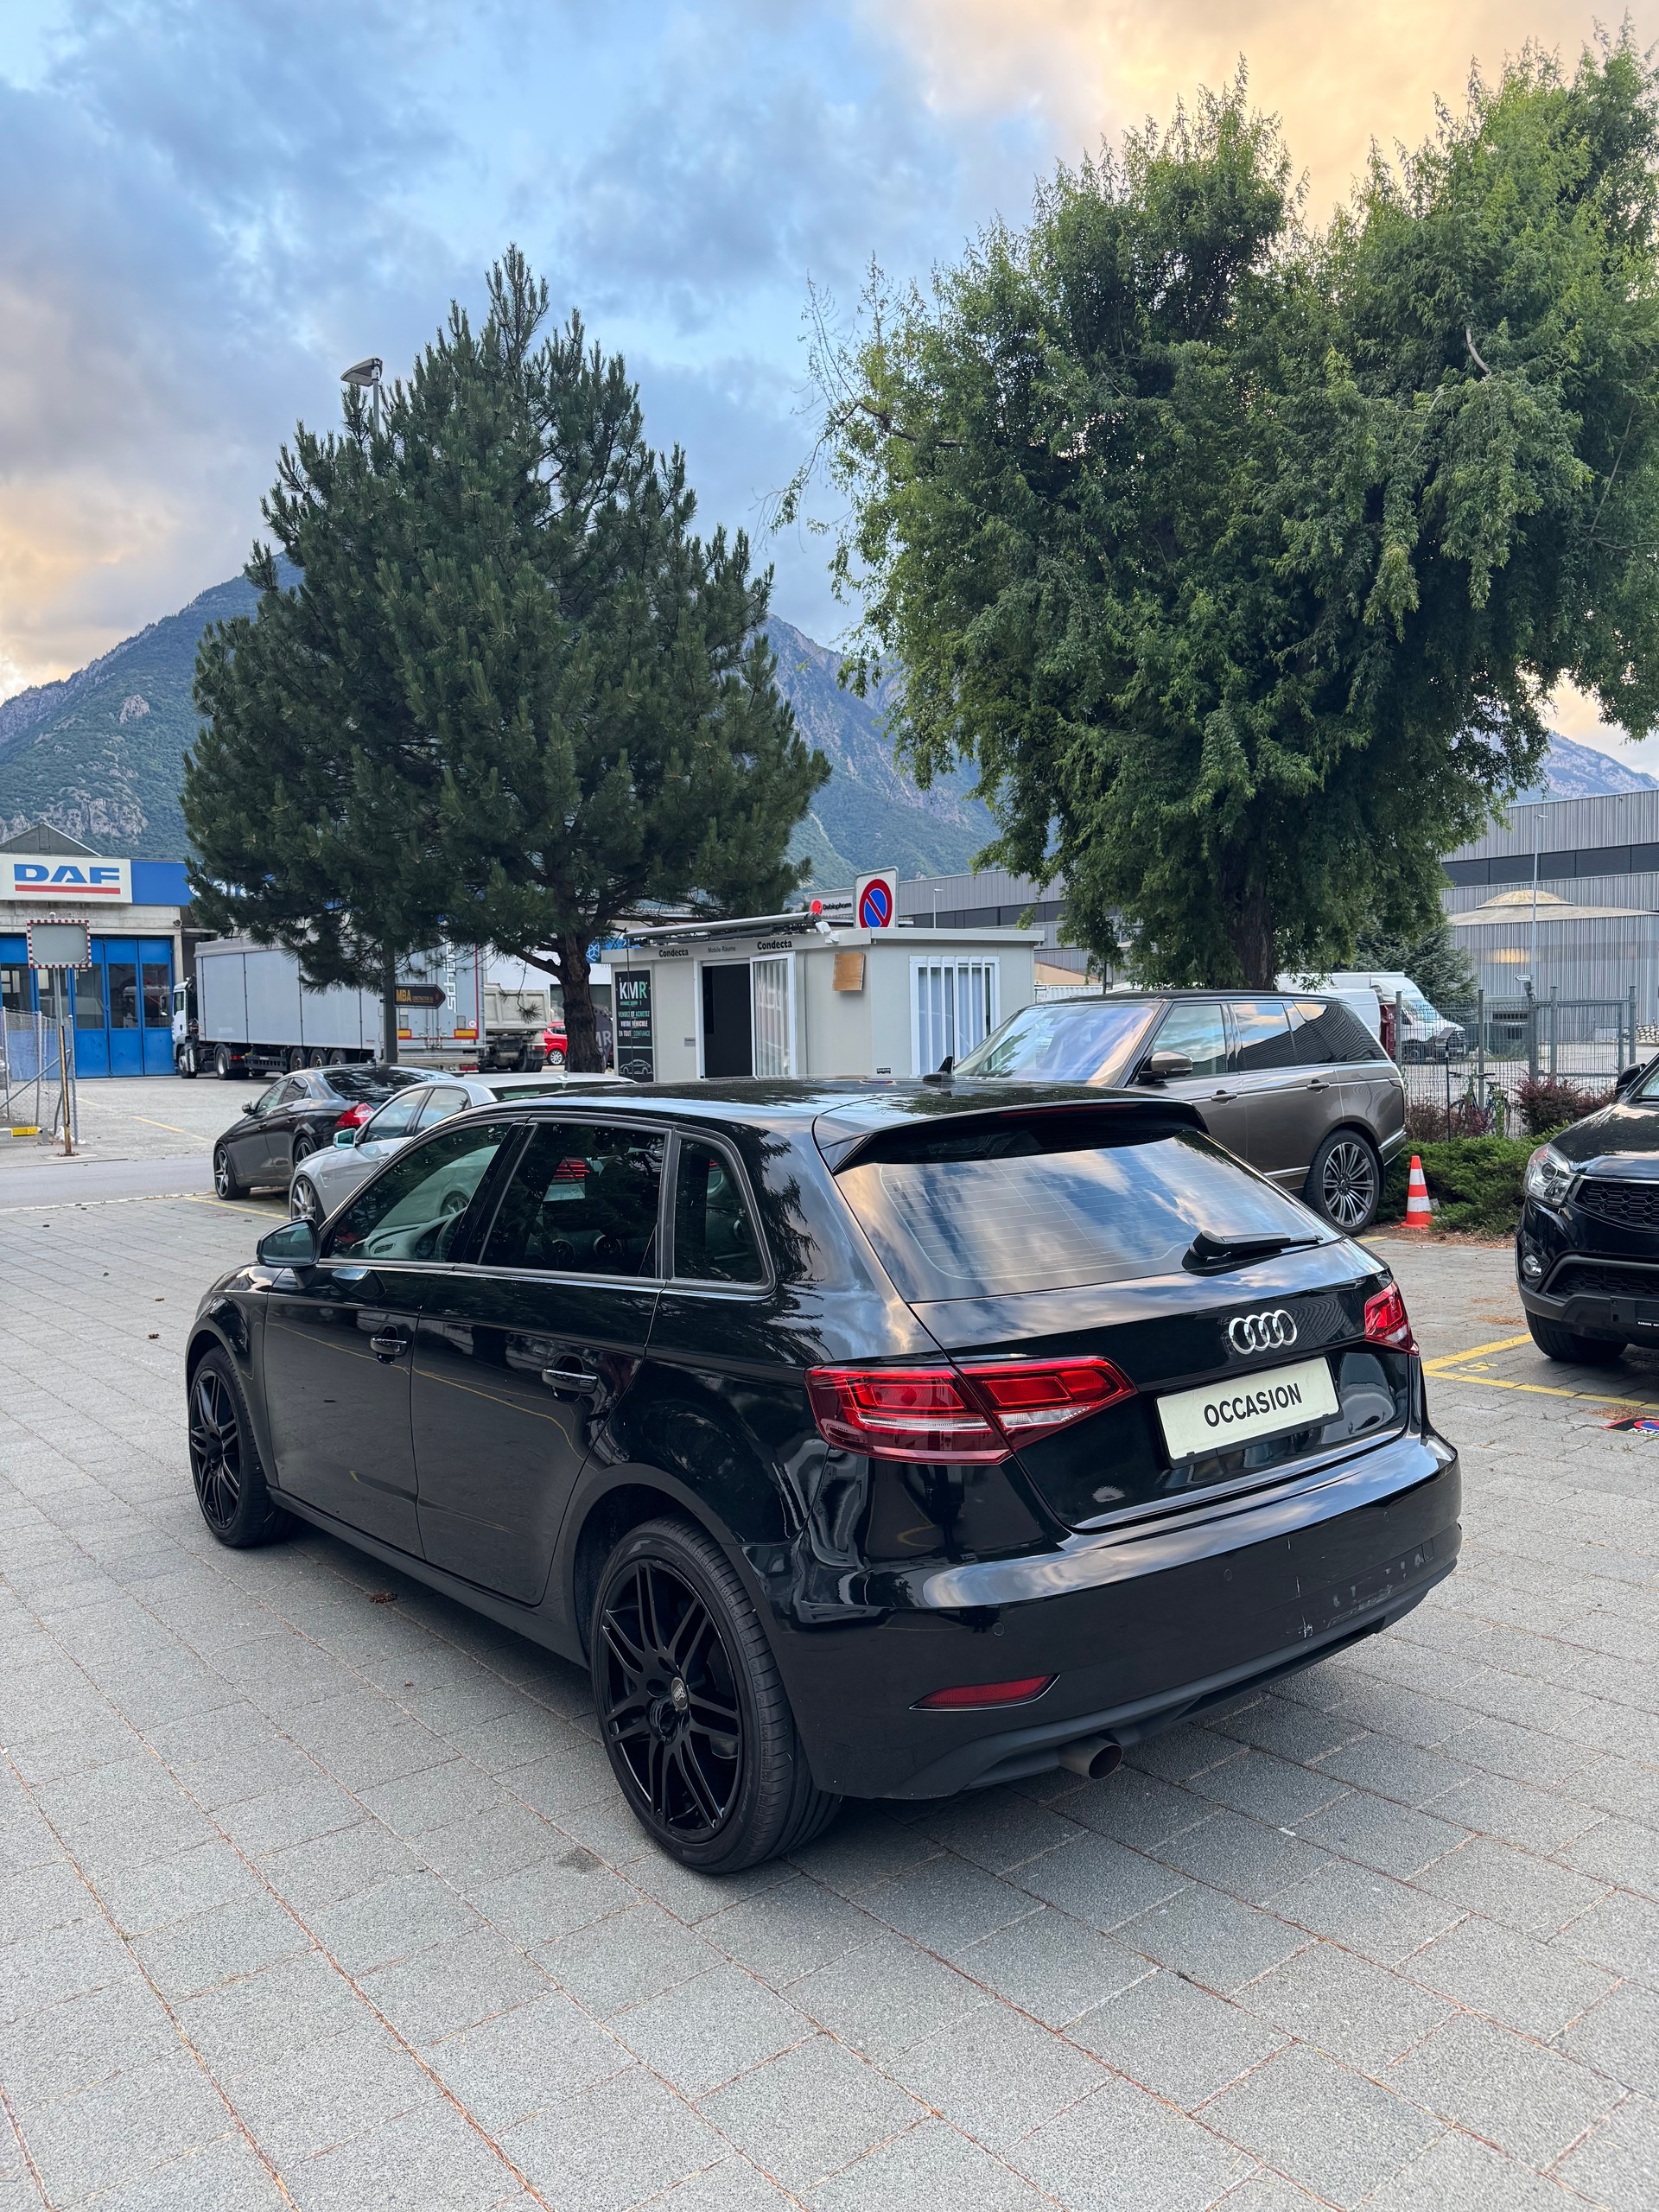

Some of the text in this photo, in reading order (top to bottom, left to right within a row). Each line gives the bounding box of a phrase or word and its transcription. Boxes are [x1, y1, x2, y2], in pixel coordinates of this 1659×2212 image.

[14, 863, 120, 884] DAF
[658, 948, 689, 957] Condecta
[757, 939, 792, 950] Condecta
[396, 989, 412, 1002] MBA
[620, 981, 648, 1000] KMR
[1204, 1382, 1303, 1427] OCCASION
